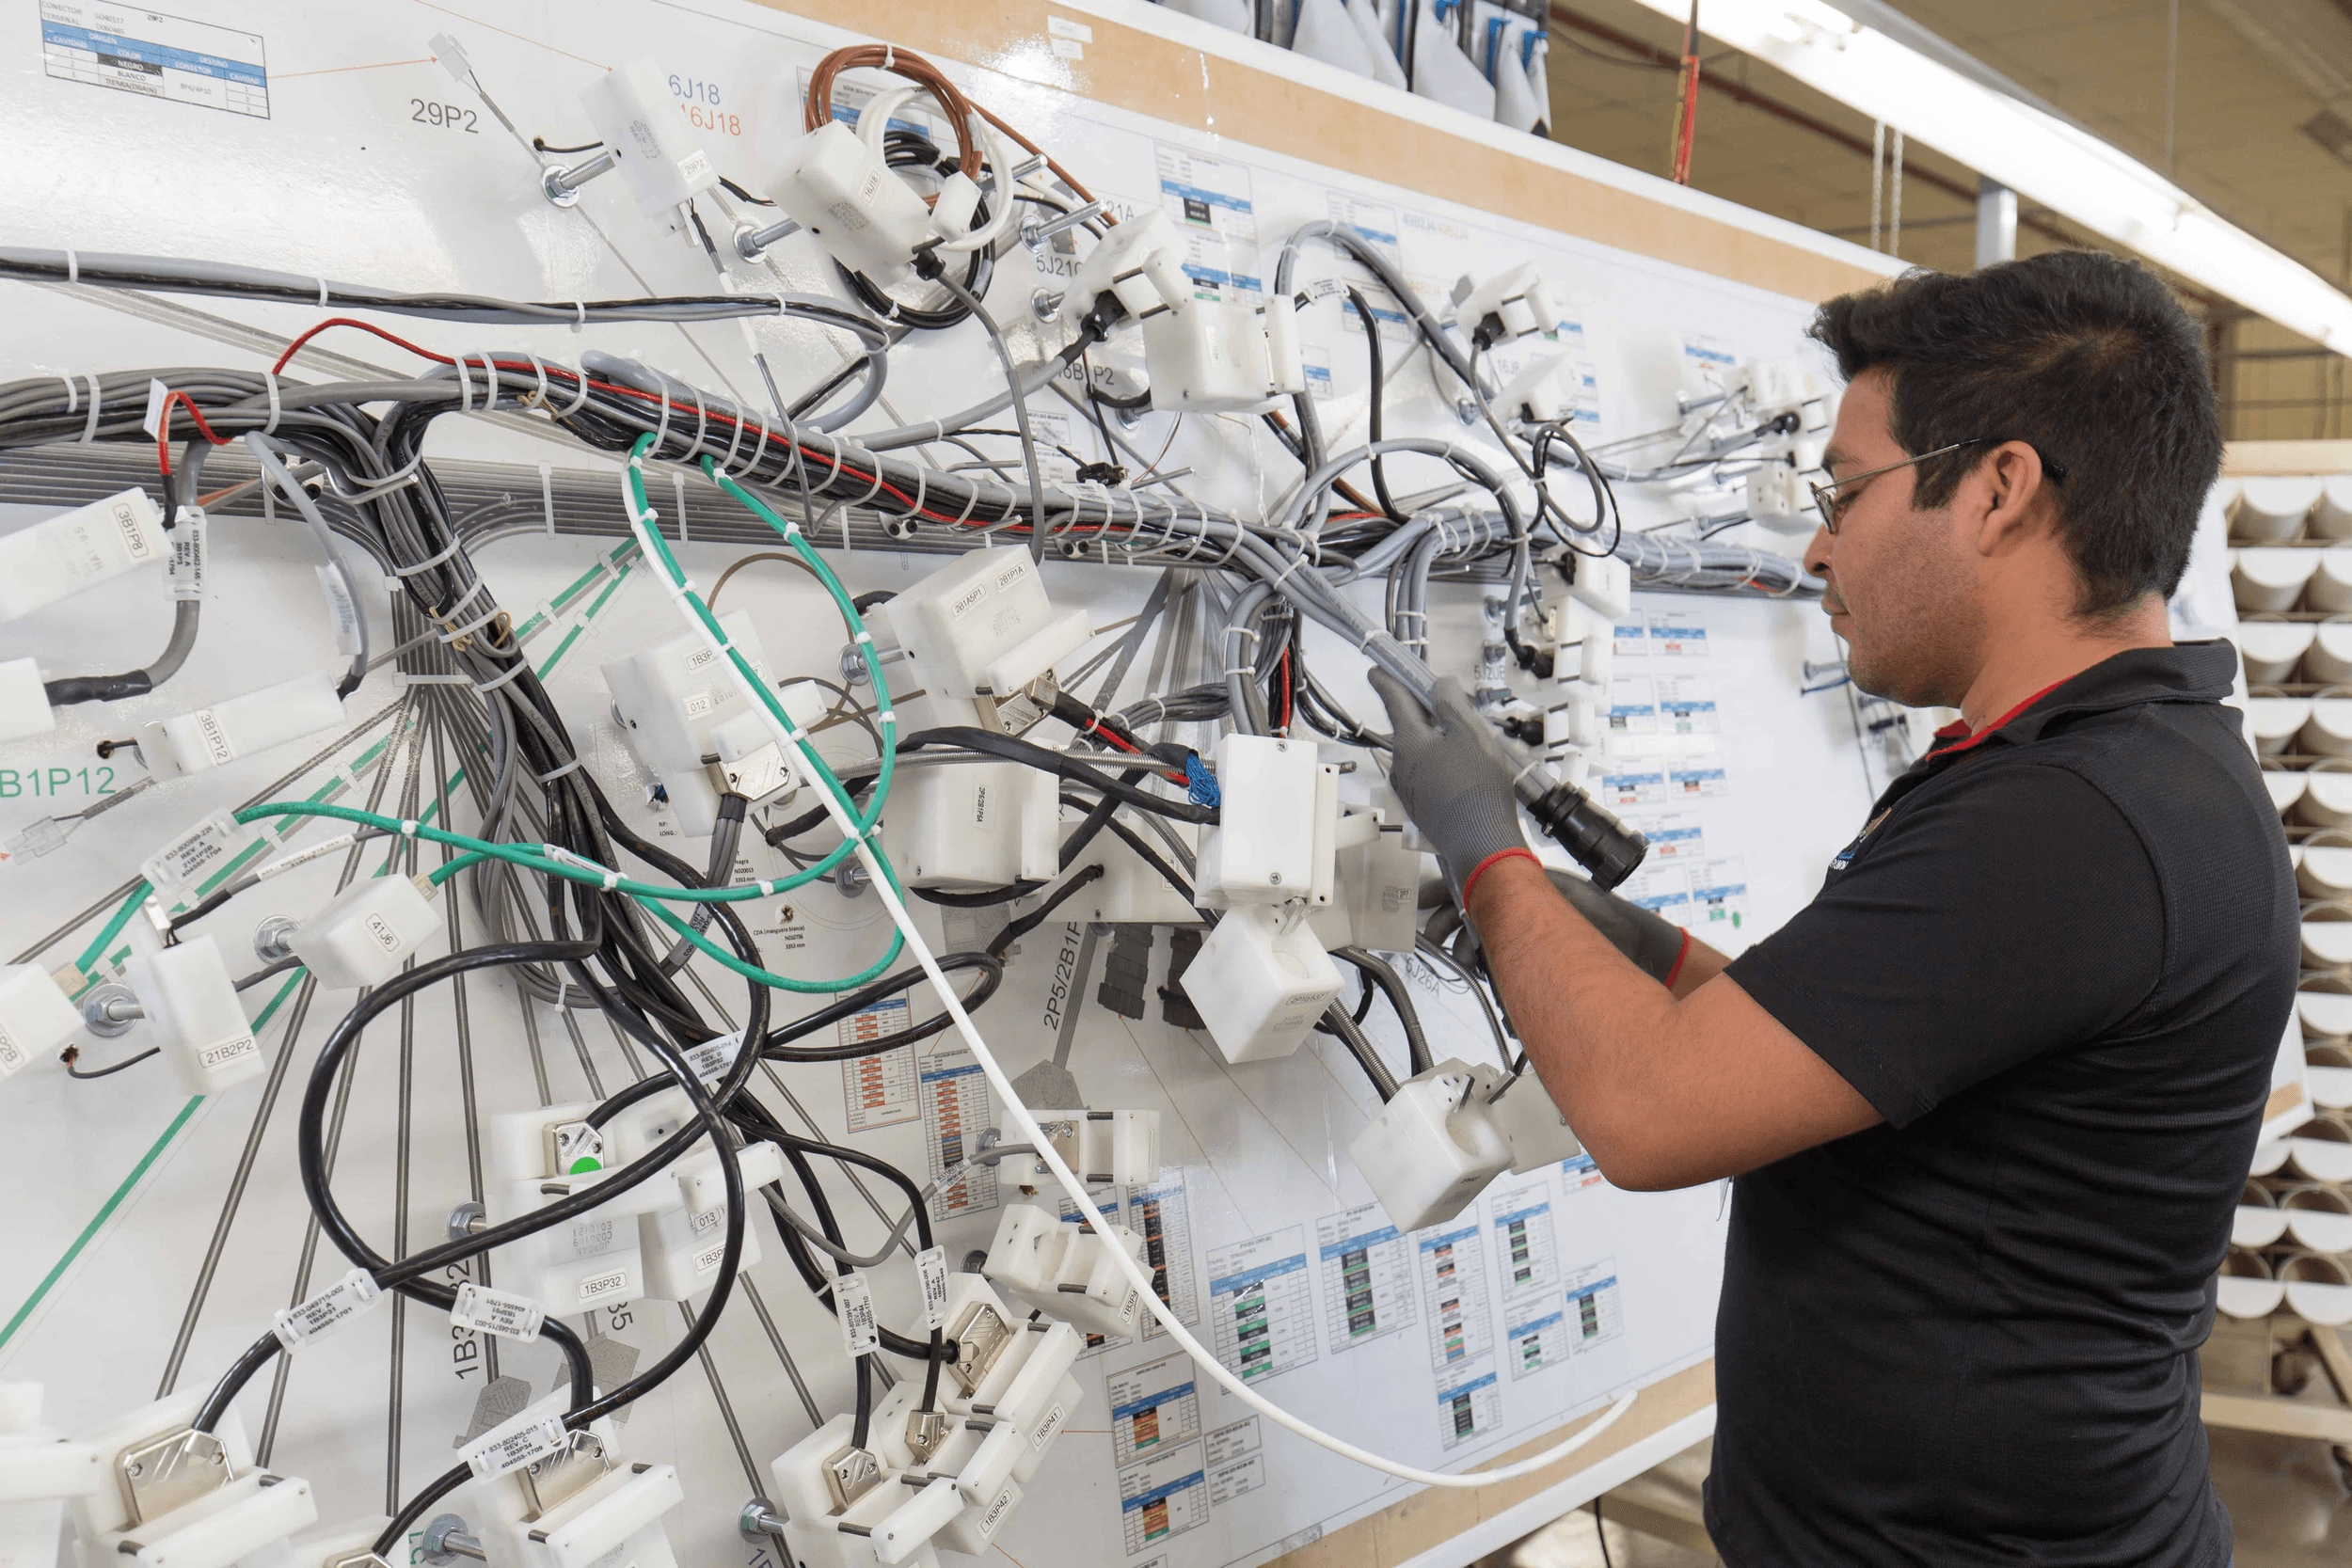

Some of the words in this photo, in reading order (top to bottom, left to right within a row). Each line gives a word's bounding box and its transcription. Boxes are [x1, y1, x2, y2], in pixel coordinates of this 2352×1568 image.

[669, 74, 720, 105] 6J18
[411, 98, 479, 134] 29P2
[685, 158, 704, 175] 29P2
[866, 175, 879, 198] 16J18
[118, 512, 144, 551] 3B1P8
[998, 566, 1024, 586] 2B1P1A
[691, 700, 707, 712] 012
[200, 715, 228, 760] 3B1P12
[373, 922, 393, 944] 41J6
[206, 1038, 254, 1065] 21B2P2
[699, 1212, 716, 1227] 013
[585, 1275, 621, 1294] 1B3P32
[1037, 1412, 1058, 1440] 1B3P41
[985, 1495, 1009, 1527] 1B3P42
